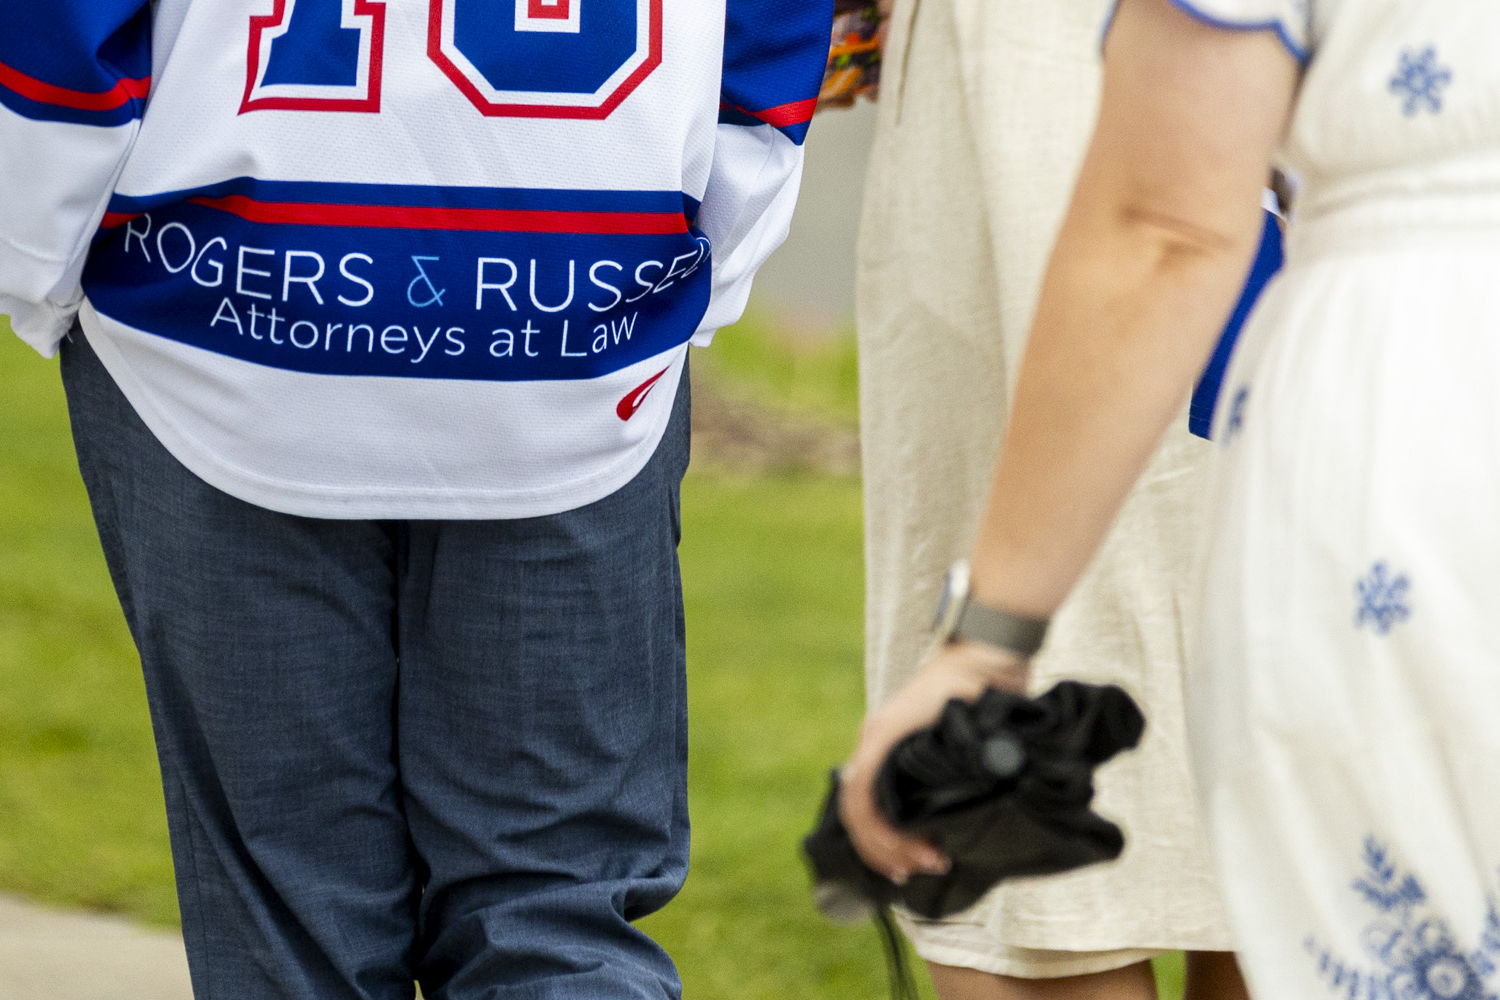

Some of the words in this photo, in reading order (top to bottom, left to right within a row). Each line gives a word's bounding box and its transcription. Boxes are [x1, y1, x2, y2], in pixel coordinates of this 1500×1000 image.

[124, 212, 375, 307] ROGERS
[407, 255, 446, 308] &
[210, 297, 466, 363] Attorneys
[489, 319, 541, 358] at
[561, 311, 639, 357] Law
